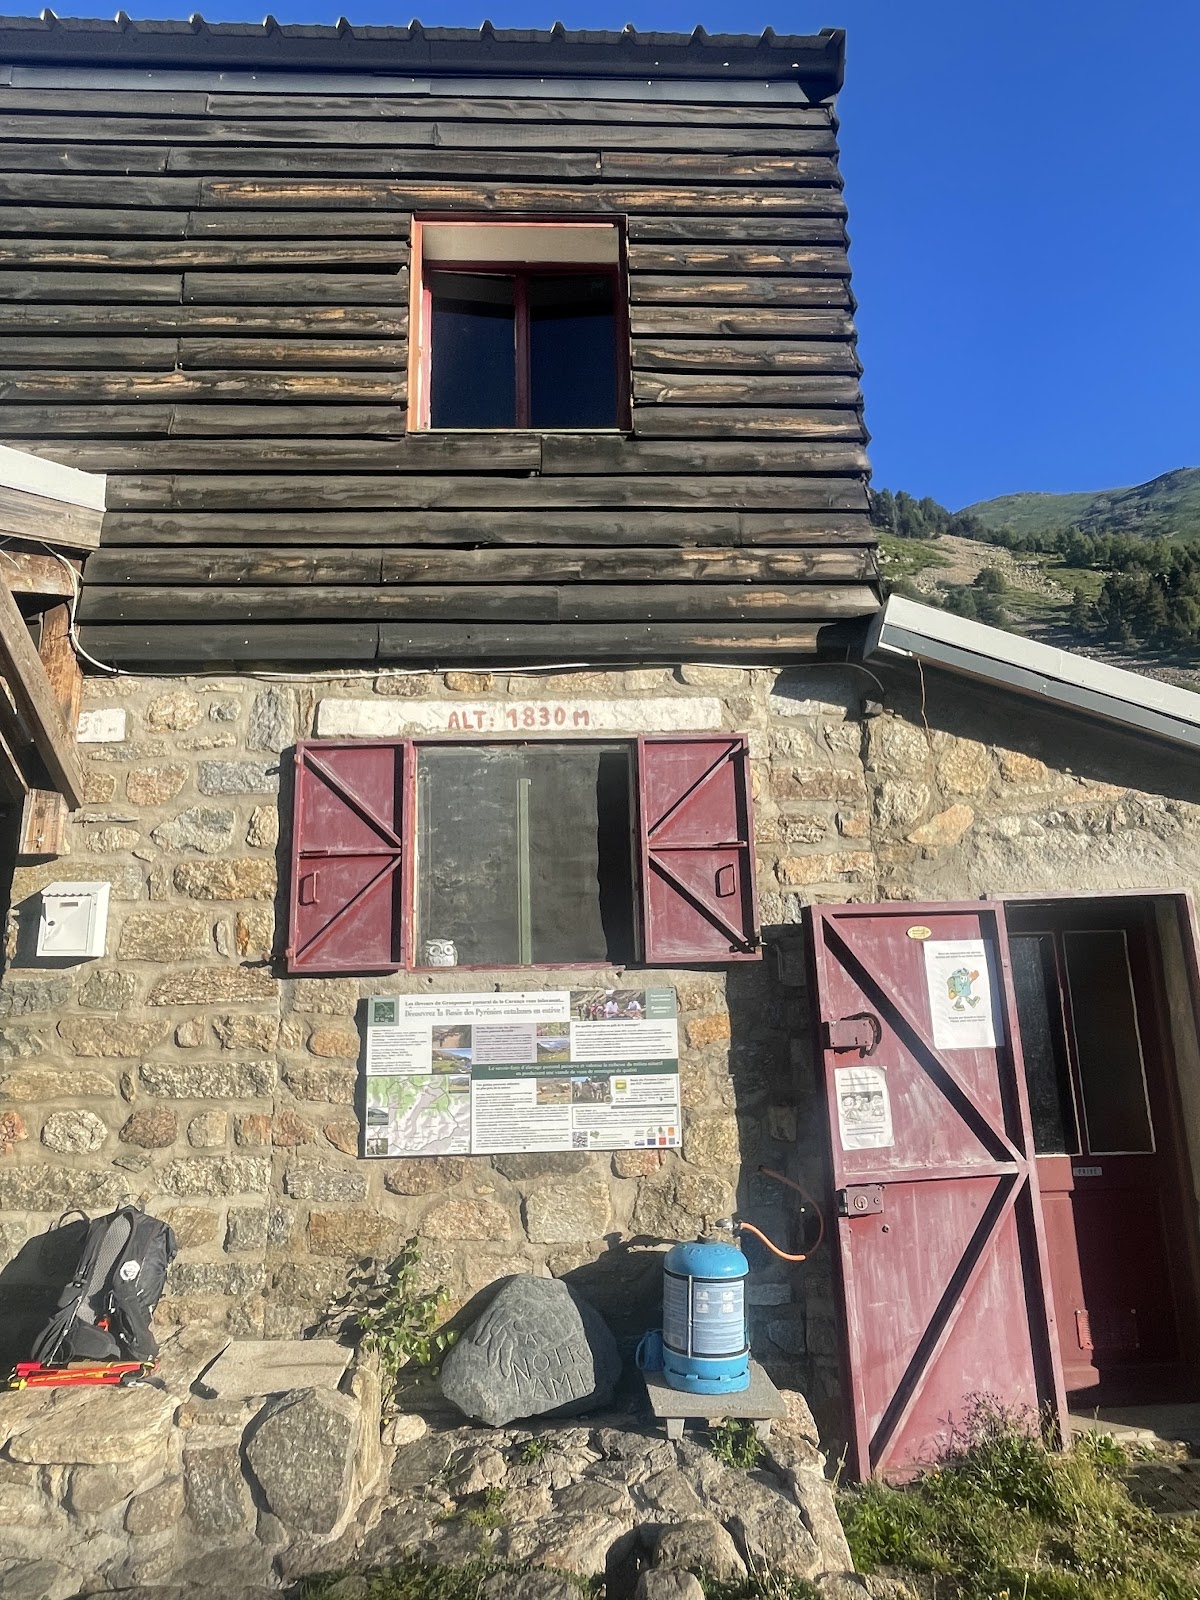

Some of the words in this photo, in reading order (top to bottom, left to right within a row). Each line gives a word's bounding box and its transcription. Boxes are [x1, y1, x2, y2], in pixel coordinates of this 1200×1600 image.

[448, 710, 495, 730] ALT:
[506, 706, 566, 728] 1830
[572, 709, 590, 727] M
[476, 1008, 502, 1017] Pyrénées
